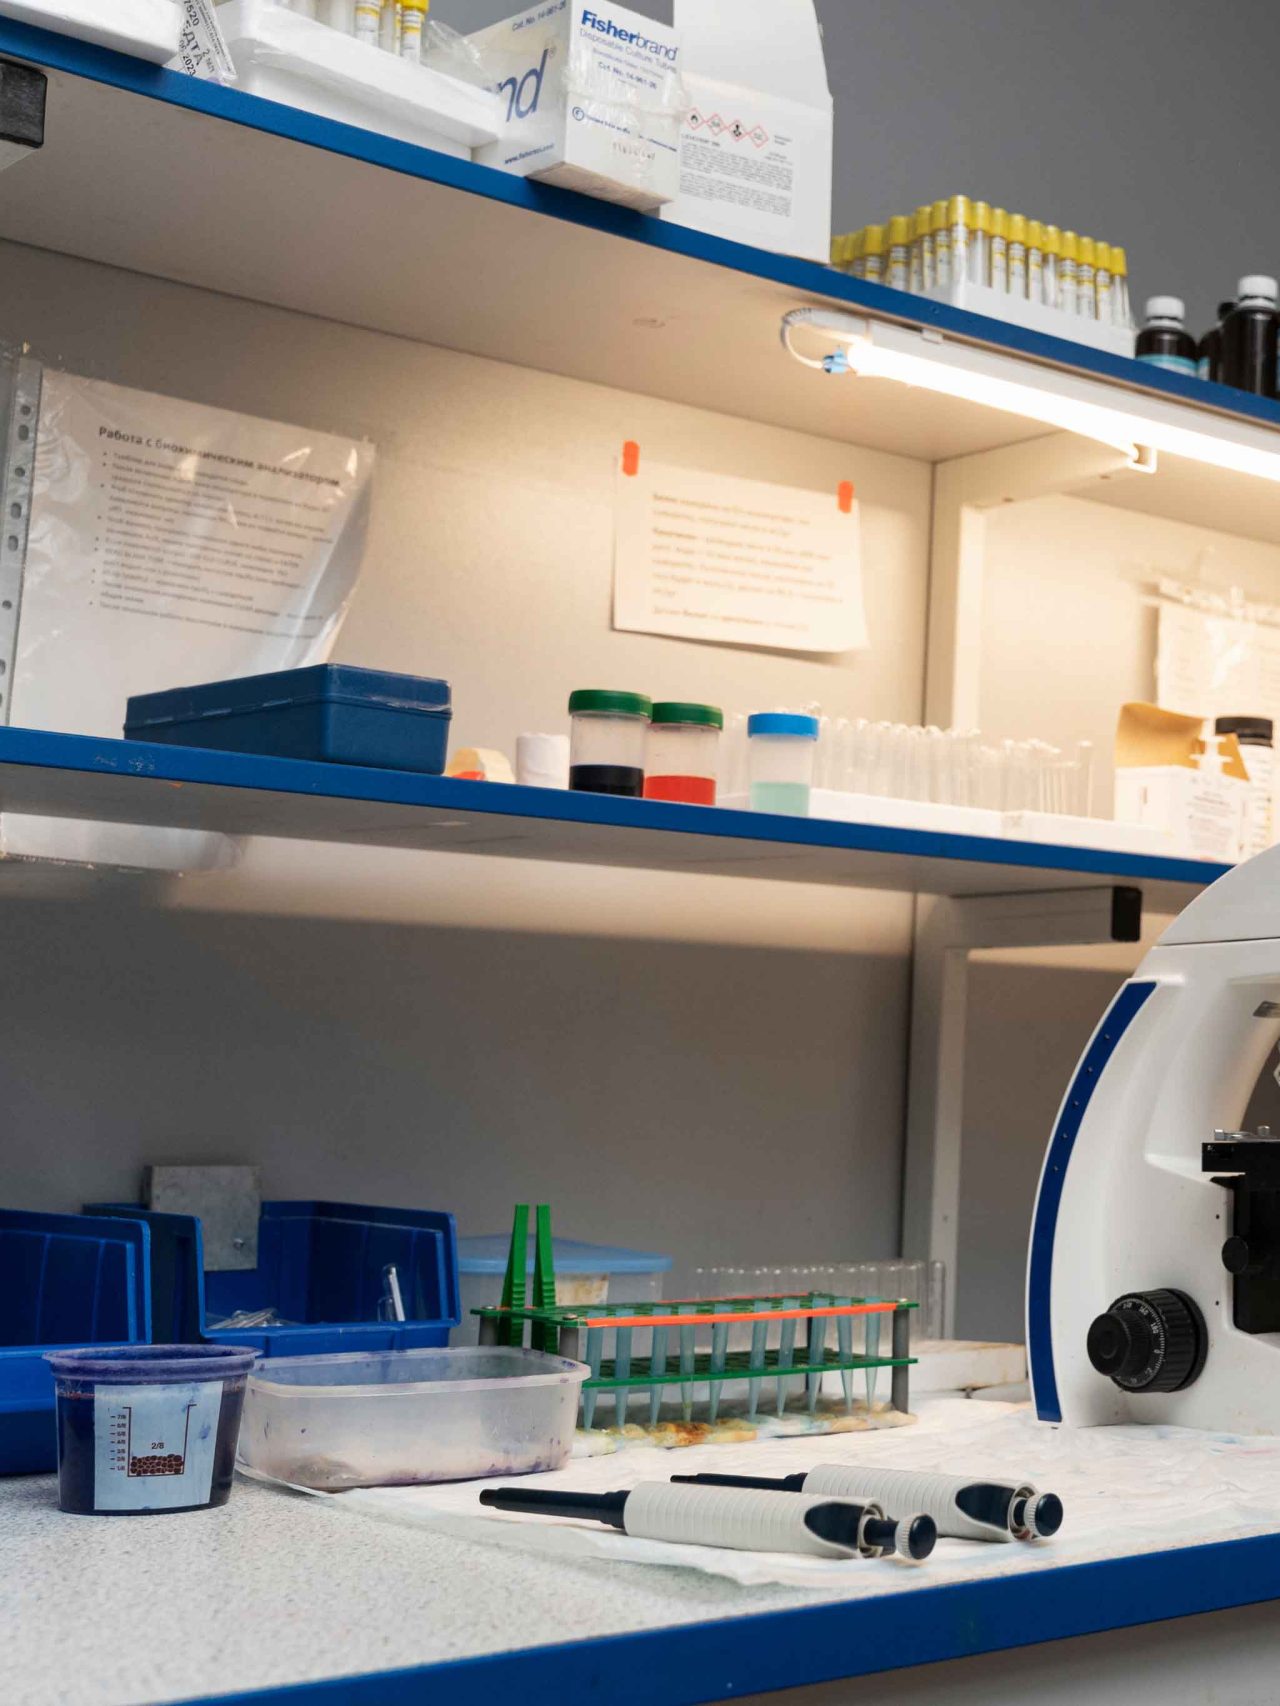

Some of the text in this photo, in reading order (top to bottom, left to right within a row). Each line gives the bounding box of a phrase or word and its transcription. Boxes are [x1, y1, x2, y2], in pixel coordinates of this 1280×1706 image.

[581, 9, 678, 61] Fisherbrand
[99, 426, 143, 446] Работа
[151, 1442, 165, 1450] 2/8
